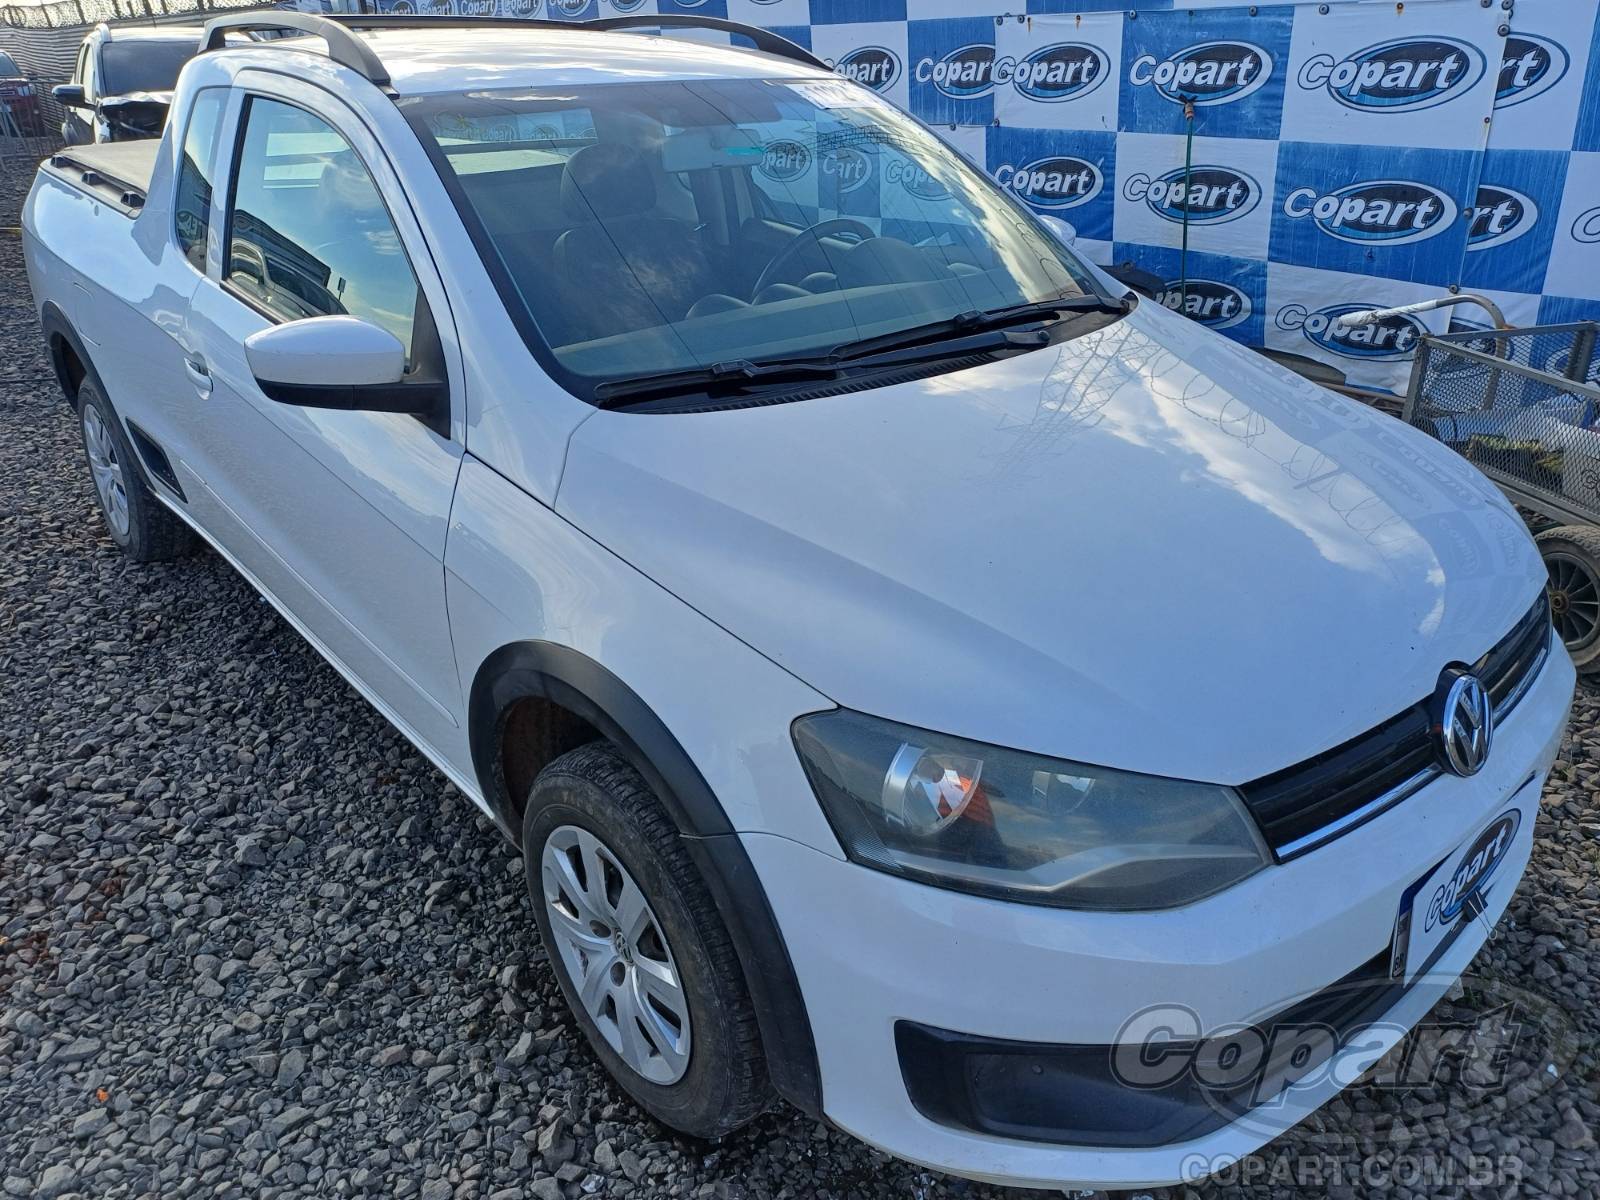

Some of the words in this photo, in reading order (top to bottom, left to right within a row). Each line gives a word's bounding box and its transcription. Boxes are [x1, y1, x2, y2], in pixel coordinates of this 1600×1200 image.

[461, 0, 493, 15] Copart
[824, 58, 890, 82] opart
[995, 51, 1094, 88] Copart
[1130, 52, 1253, 92] Copart
[1298, 50, 1460, 96] Copart
[762, 149, 804, 171] part
[994, 165, 1091, 197] Copart
[1123, 177, 1244, 210] Copart
[1284, 188, 1437, 229] Copart
[1156, 292, 1235, 318] part
[1275, 304, 1416, 350] Copart
[1425, 823, 1507, 933] Copart
